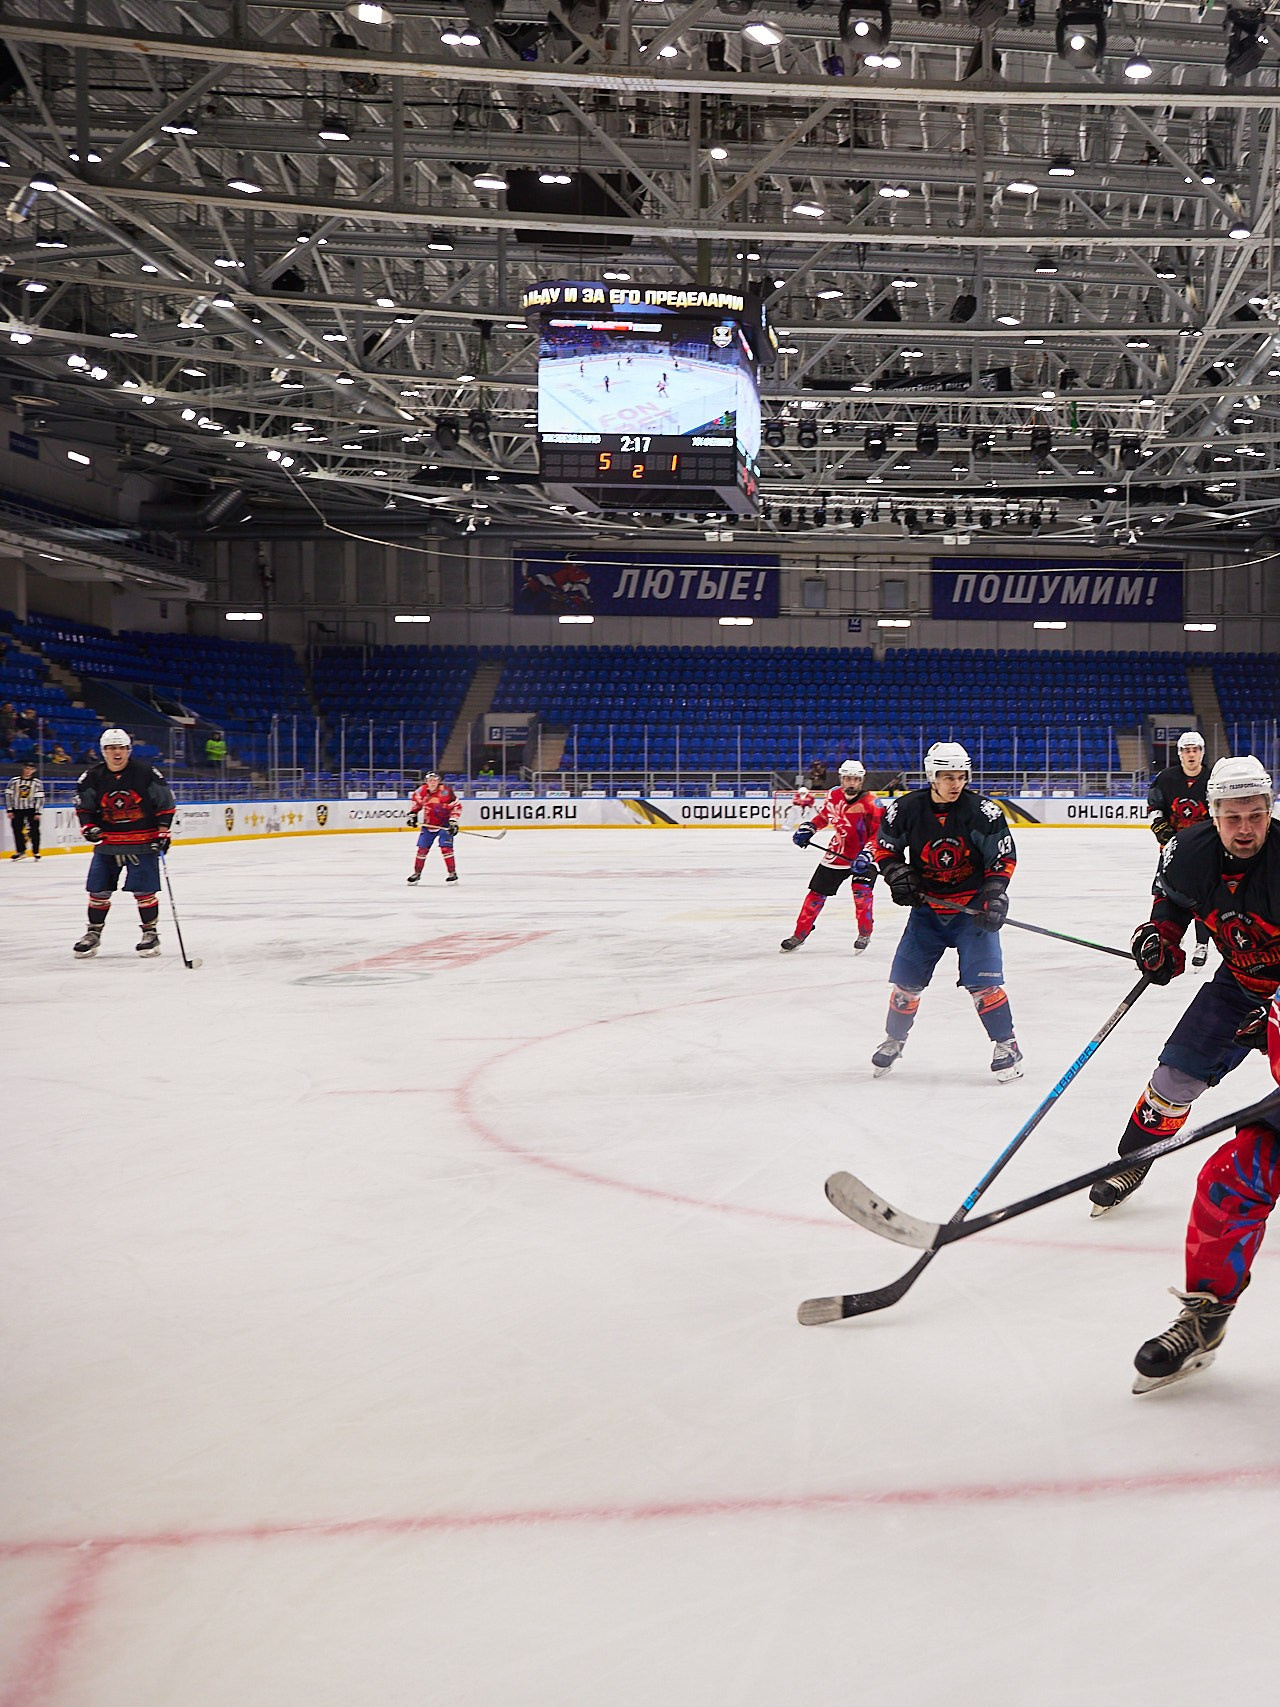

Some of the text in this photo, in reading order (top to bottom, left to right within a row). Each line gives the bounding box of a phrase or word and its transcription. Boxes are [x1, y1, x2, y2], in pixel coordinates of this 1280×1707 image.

[564, 288, 577, 303] И
[582, 288, 605, 304] ЗА
[609, 289, 640, 305] ЕГО
[644, 290, 744, 311] ПРЕДЕЛАМИ
[620, 436, 651, 452] 2:17
[598, 453, 612, 470] 5
[671, 455, 677, 471] 1
[632, 464, 644, 478] 2
[612, 569, 766, 601] ЛЮТЫЕ!
[952, 574, 1158, 606] ПОШУМИМ!
[480, 805, 577, 820] OHLIGA.RU
[682, 806, 804, 820] ОФИЦЕРСК
[1068, 805, 1148, 819] OHLIGA.RU
[1098, 1010, 1122, 1038] NEXUS
[1058, 1046, 1094, 1089] BAUER
